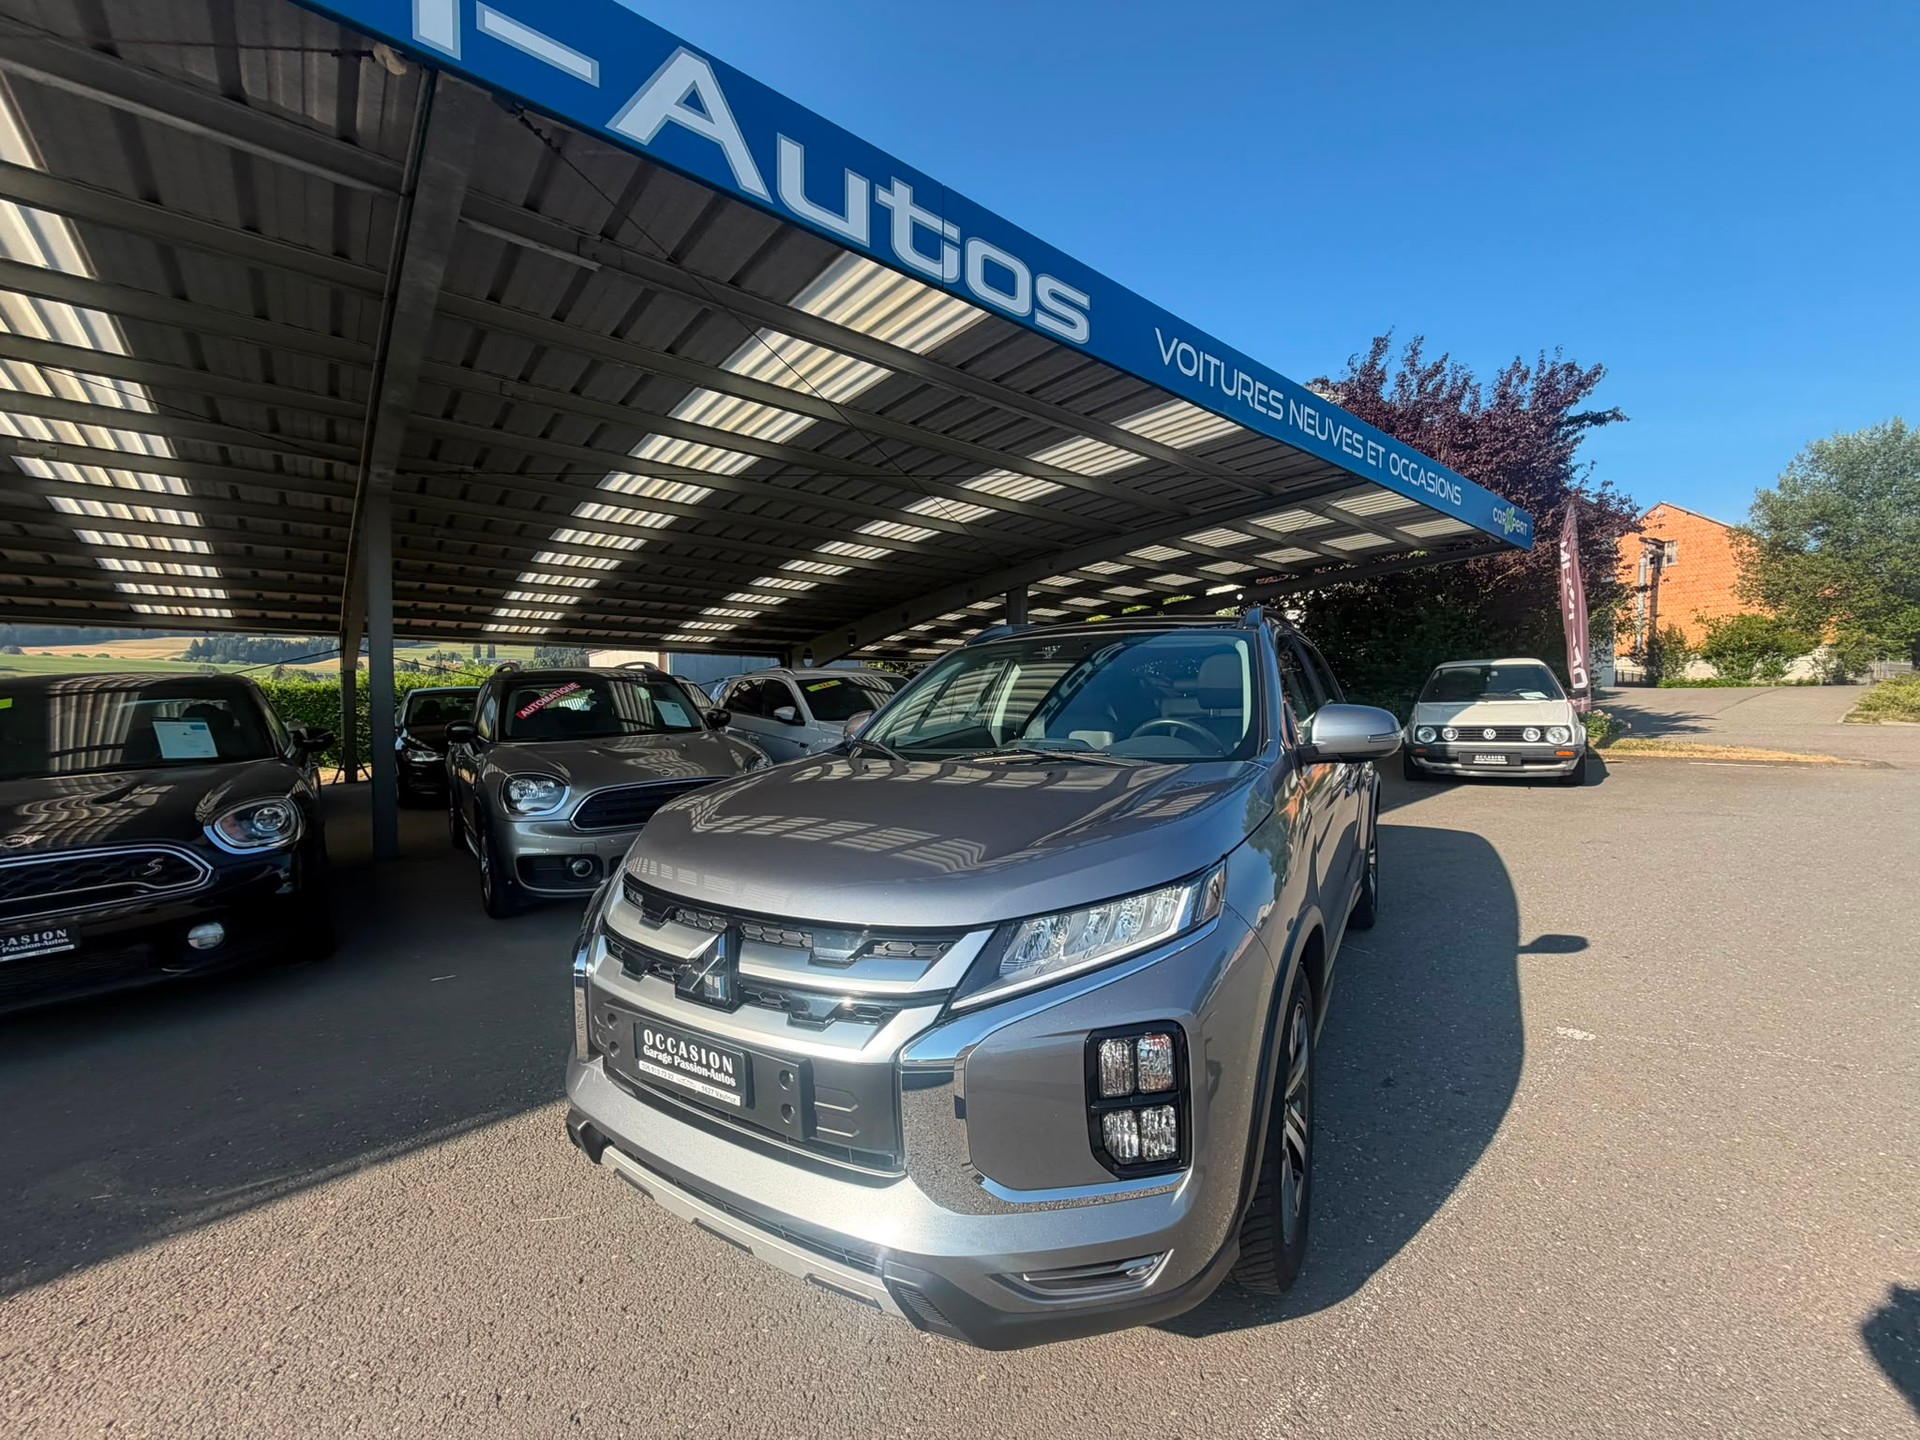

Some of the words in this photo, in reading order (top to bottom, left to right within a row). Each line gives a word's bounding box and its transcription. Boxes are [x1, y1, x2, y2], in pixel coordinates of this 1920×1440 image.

[1155, 327, 1284, 420] VOITURES
[1289, 398, 1364, 460] NEUVES
[1366, 439, 1386, 469] ET
[1389, 452, 1462, 506] OCCASIONS
[520, 682, 580, 718] AUTOMATIQUE
[643, 1029, 734, 1074] OCCASION
[643, 1045, 672, 1065] Garage
[674, 1055, 737, 1088] Passion-Autos
